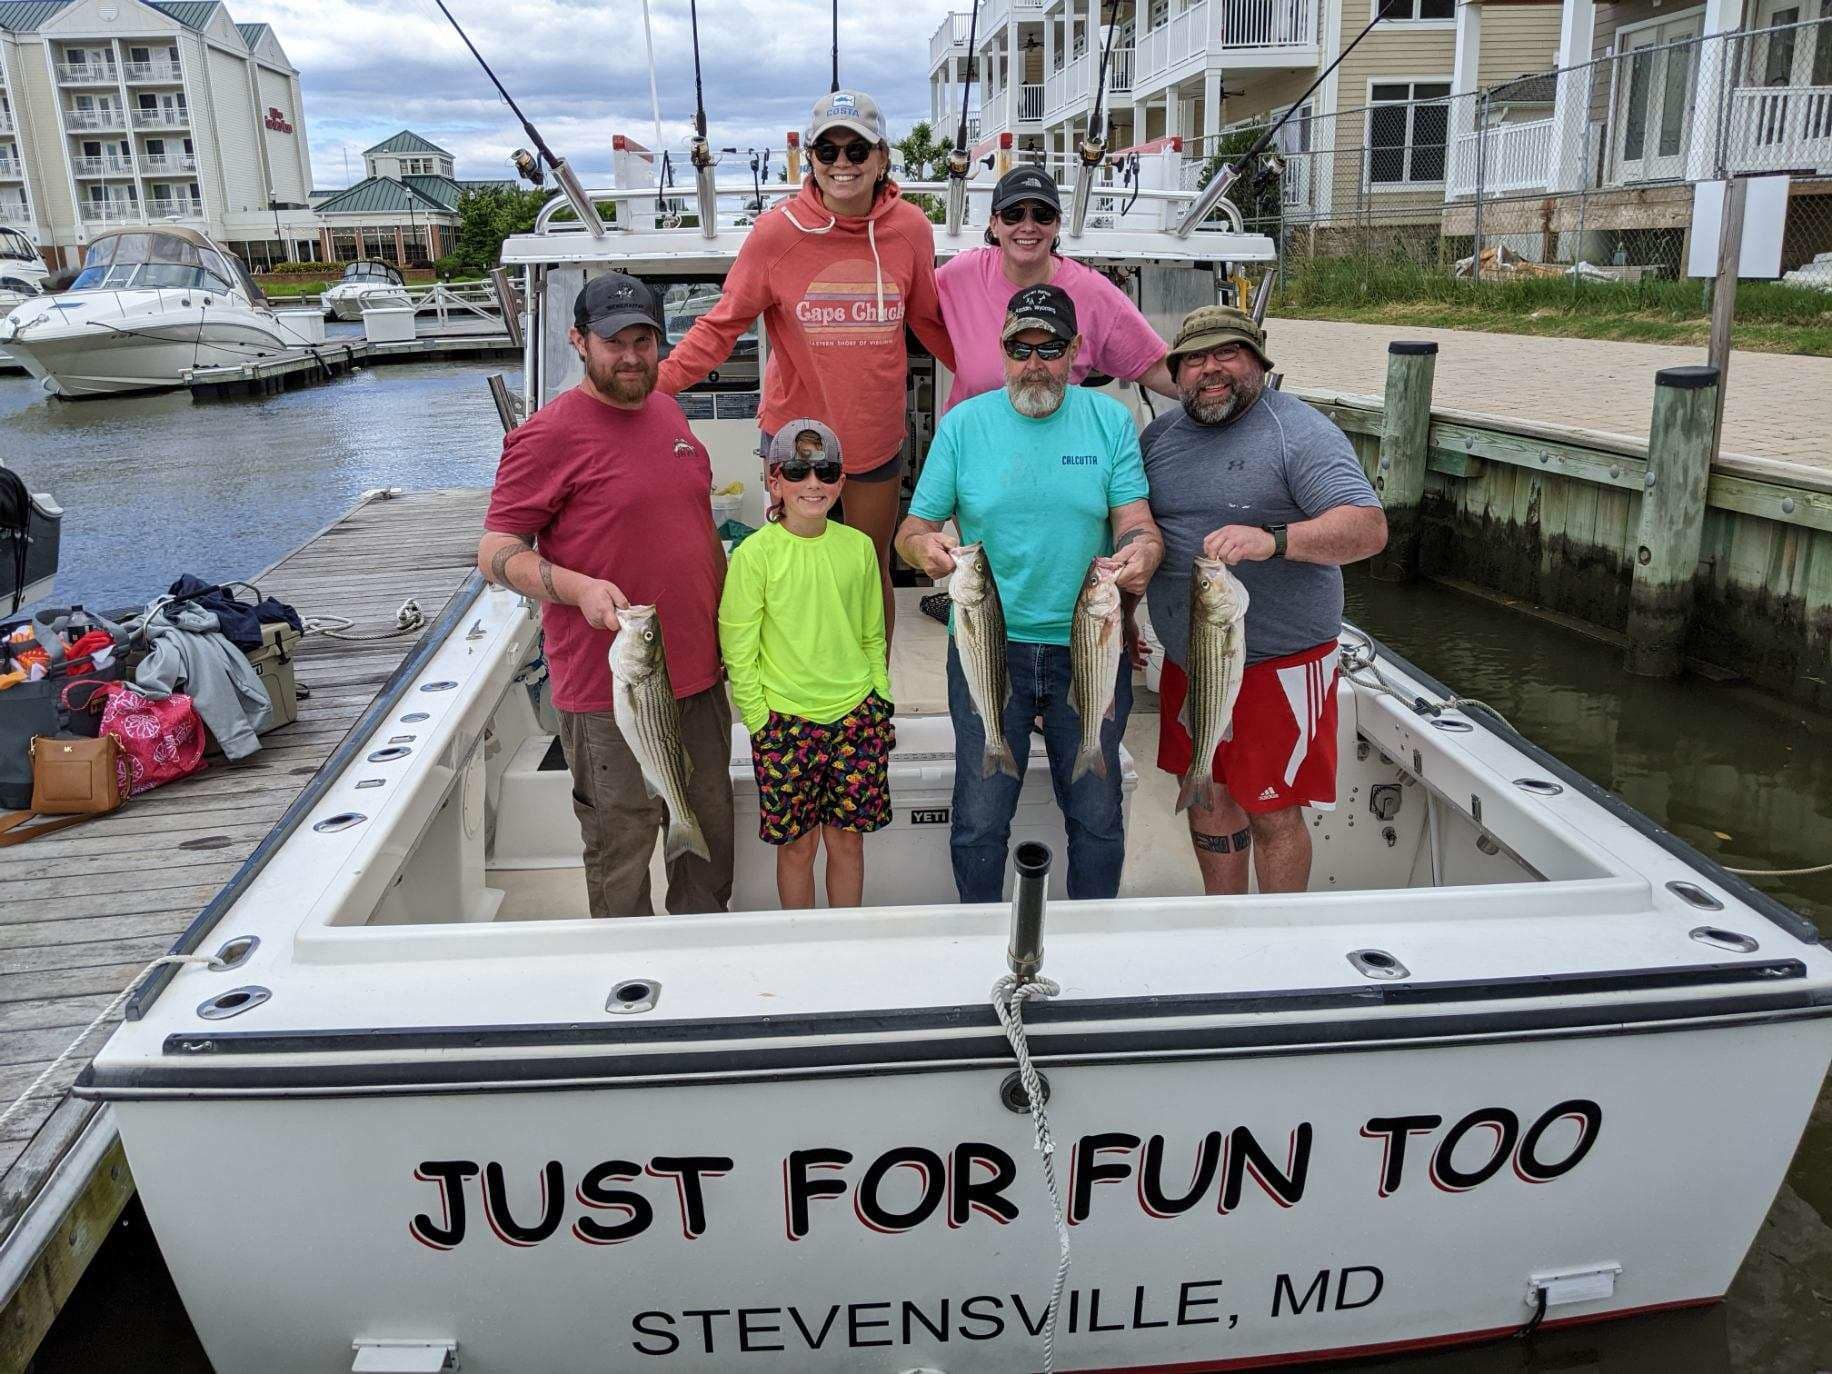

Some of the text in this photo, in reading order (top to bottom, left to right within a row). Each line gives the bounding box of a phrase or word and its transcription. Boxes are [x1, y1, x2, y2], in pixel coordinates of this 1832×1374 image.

[826, 107, 860, 118] COSTA
[796, 301, 846, 326] Cape
[1061, 455, 1098, 465] CALCUTTA
[913, 811, 946, 822] YETI
[409, 1099, 1602, 1250] JUST FOR FUN TOO
[631, 1265, 1384, 1356] STEVENSVILLE, MD
